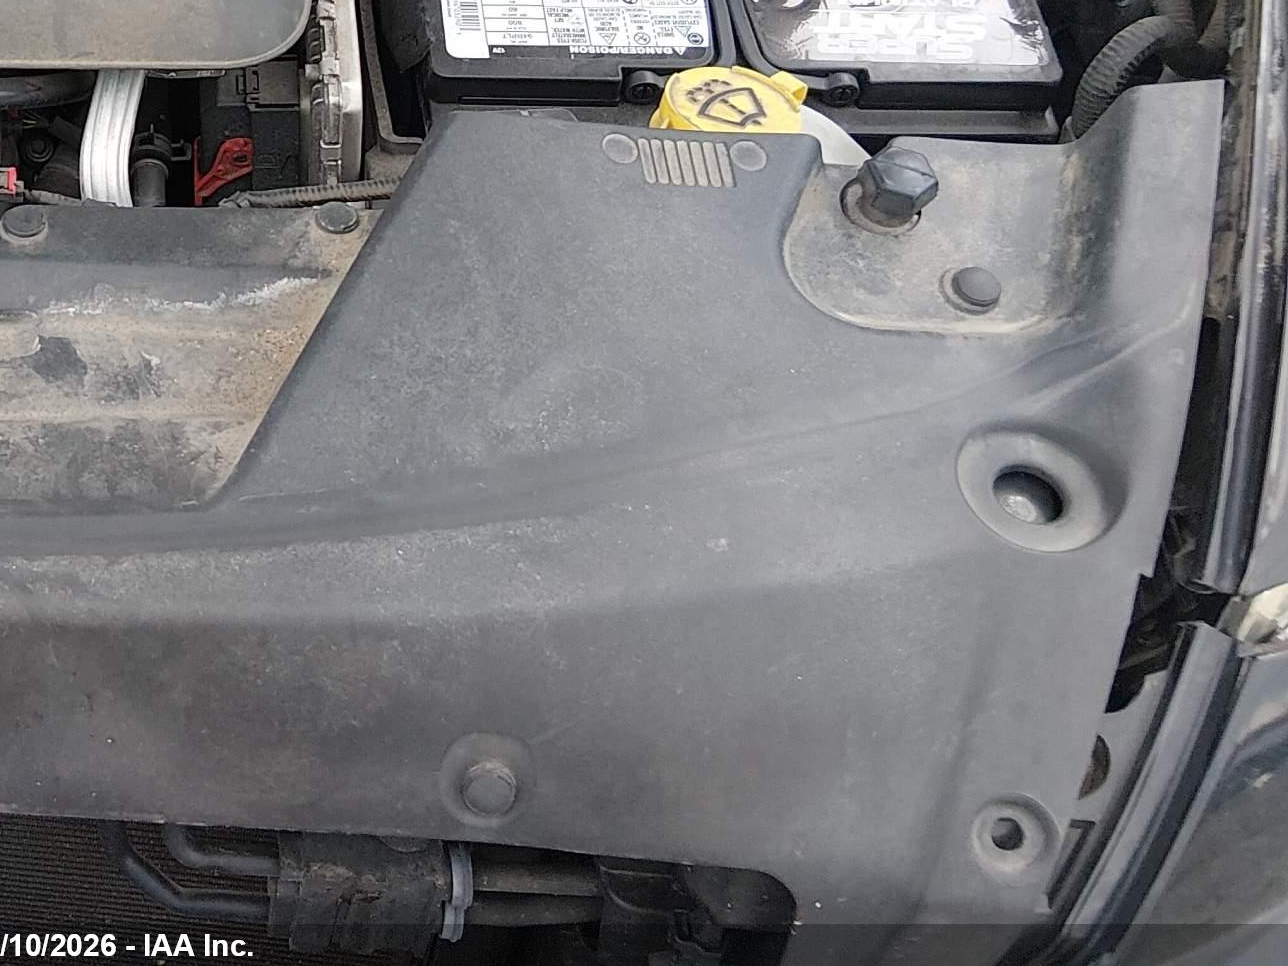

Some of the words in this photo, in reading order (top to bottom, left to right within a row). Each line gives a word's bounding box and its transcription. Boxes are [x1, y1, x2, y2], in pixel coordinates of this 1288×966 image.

[810, 12, 986, 42] START
[570, 45, 674, 54] DANGER/POISON
[817, 36, 974, 59] SUPER
